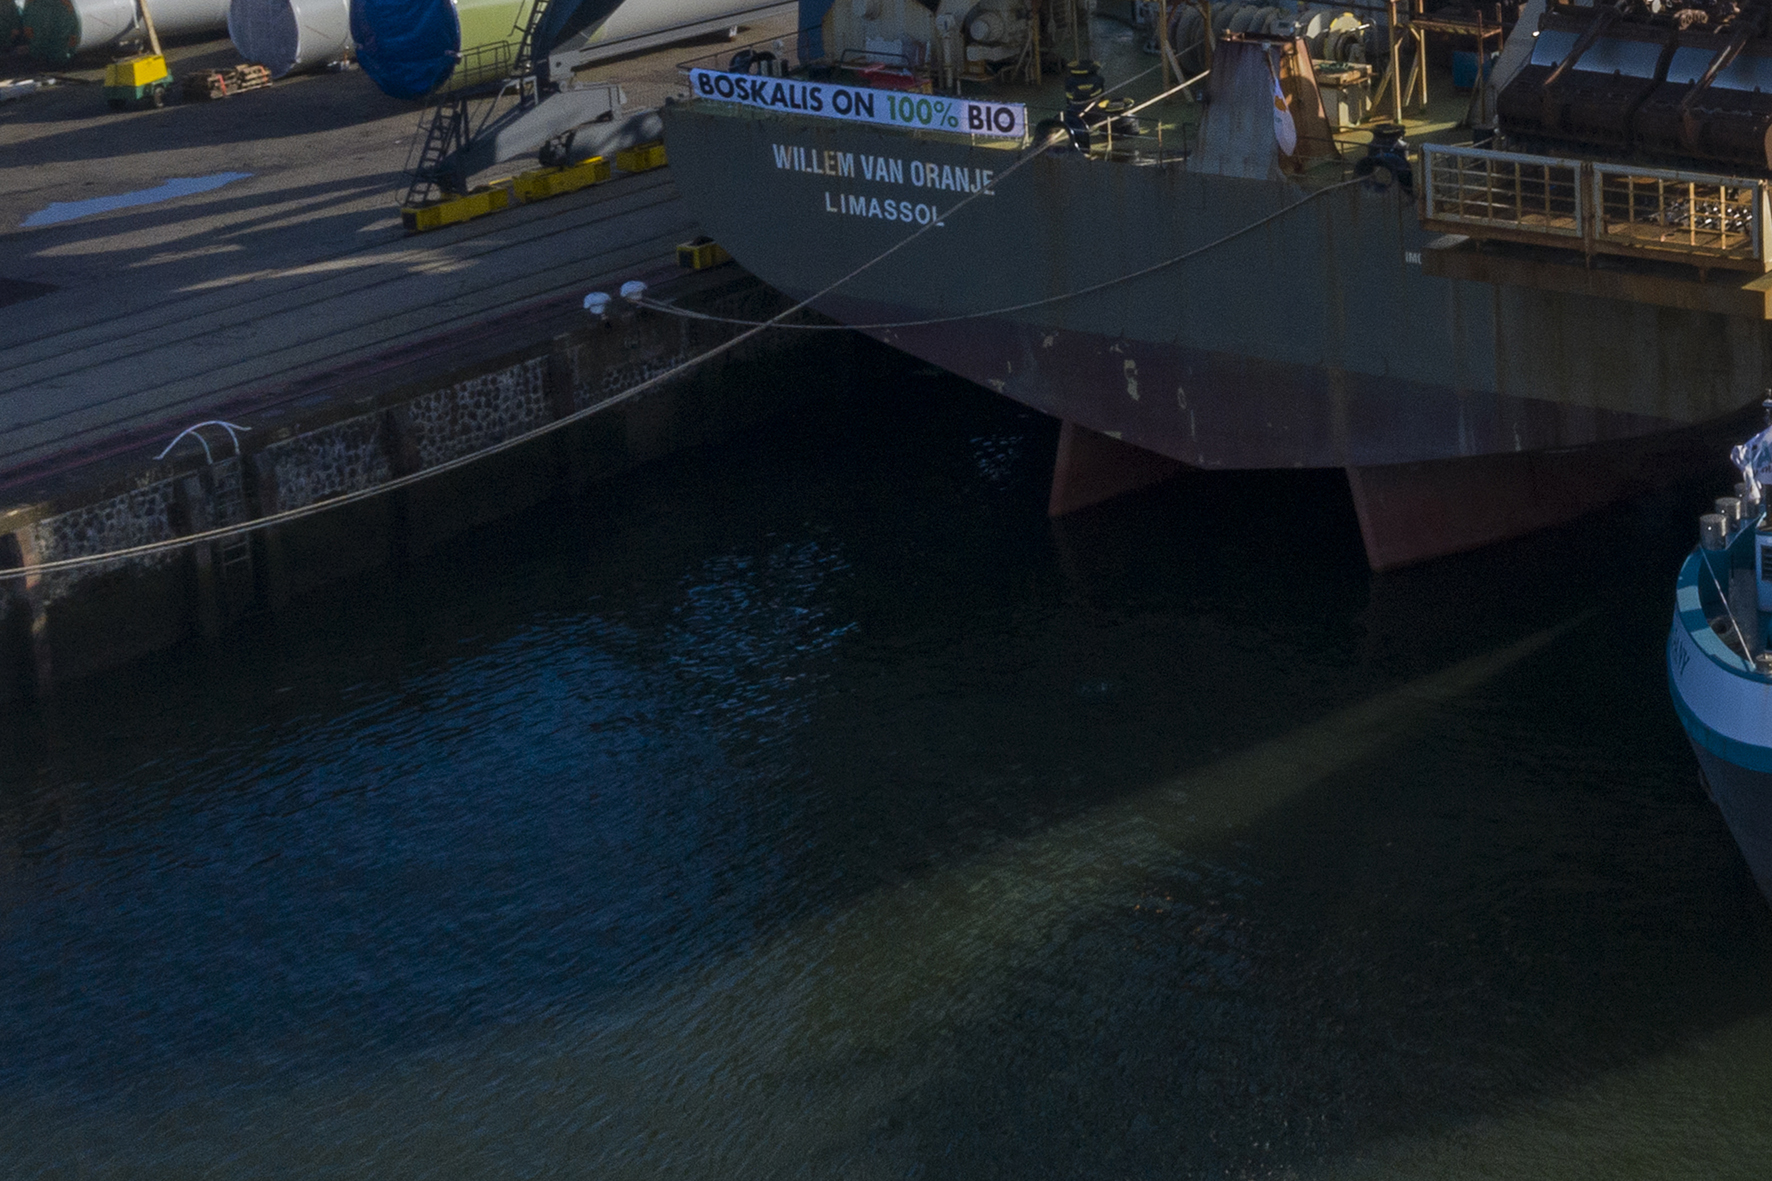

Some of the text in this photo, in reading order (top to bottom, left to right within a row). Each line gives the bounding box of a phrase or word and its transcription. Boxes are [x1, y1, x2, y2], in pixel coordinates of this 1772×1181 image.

[697, 73, 1016, 134] BOSKALIS ON 100% BIO
[772, 143, 996, 196] WILLEM VAN ORANJE
[824, 191, 946, 228] LIMASSOL
